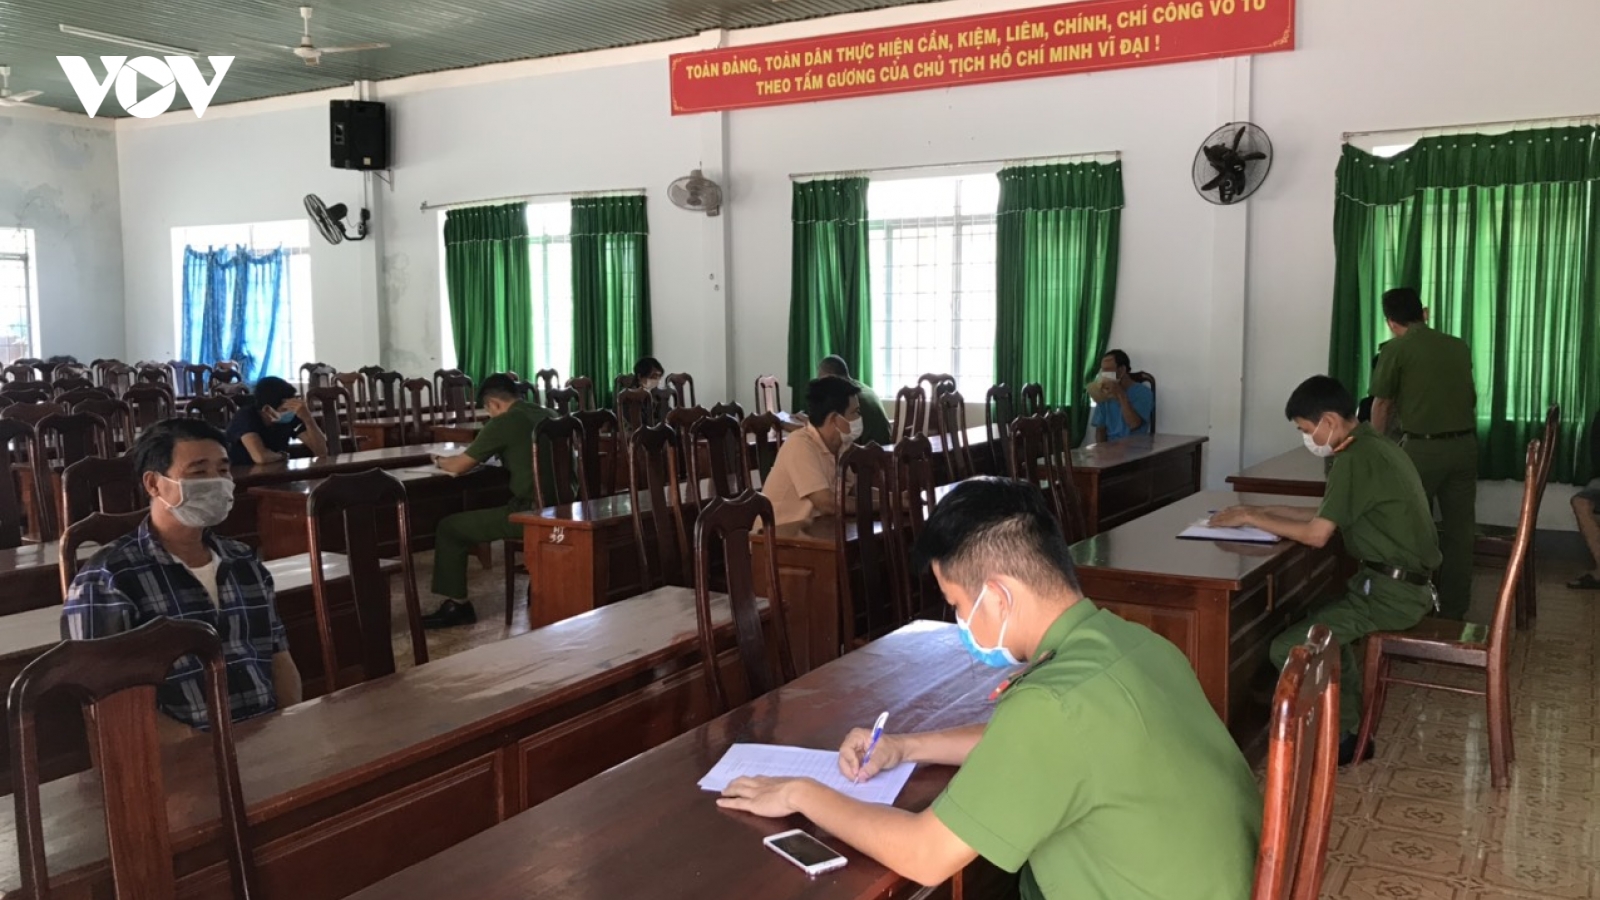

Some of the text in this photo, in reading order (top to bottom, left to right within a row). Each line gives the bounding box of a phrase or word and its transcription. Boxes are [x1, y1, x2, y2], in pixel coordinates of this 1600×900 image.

[686, 60, 720, 80] TOÀN
[722, 53, 762, 76] ĐẢNG,
[765, 50, 801, 71] TOÀN
[804, 47, 833, 67] DÂN
[837, 42, 875, 63] THỰC
[878, 36, 914, 59] HIỆN
[917, 29, 954, 53] CẦN,
[957, 26, 1002, 51] KIỆM,
[1006, 20, 1050, 43] LIÊM,
[1053, 13, 1112, 36] CHÍNH,
[1117, 4, 1148, 29] CHÍ
[1152, 1, 1204, 24] CÔNG
[756, 80, 792, 96] THEO
[795, 70, 824, 91] TẤM
[827, 67, 876, 88] GƯƠNG
[879, 60, 910, 83] CỦA
[913, 57, 945, 79] CHỦ
[949, 55, 986, 76] TỊCH
[989, 46, 1013, 69] HỒ
[1016, 44, 1045, 66] CHÍ
[1049, 42, 1093, 63] MINH
[1097, 36, 1116, 57] VĨ
[1119, 36, 1150, 59] ĐẠI
